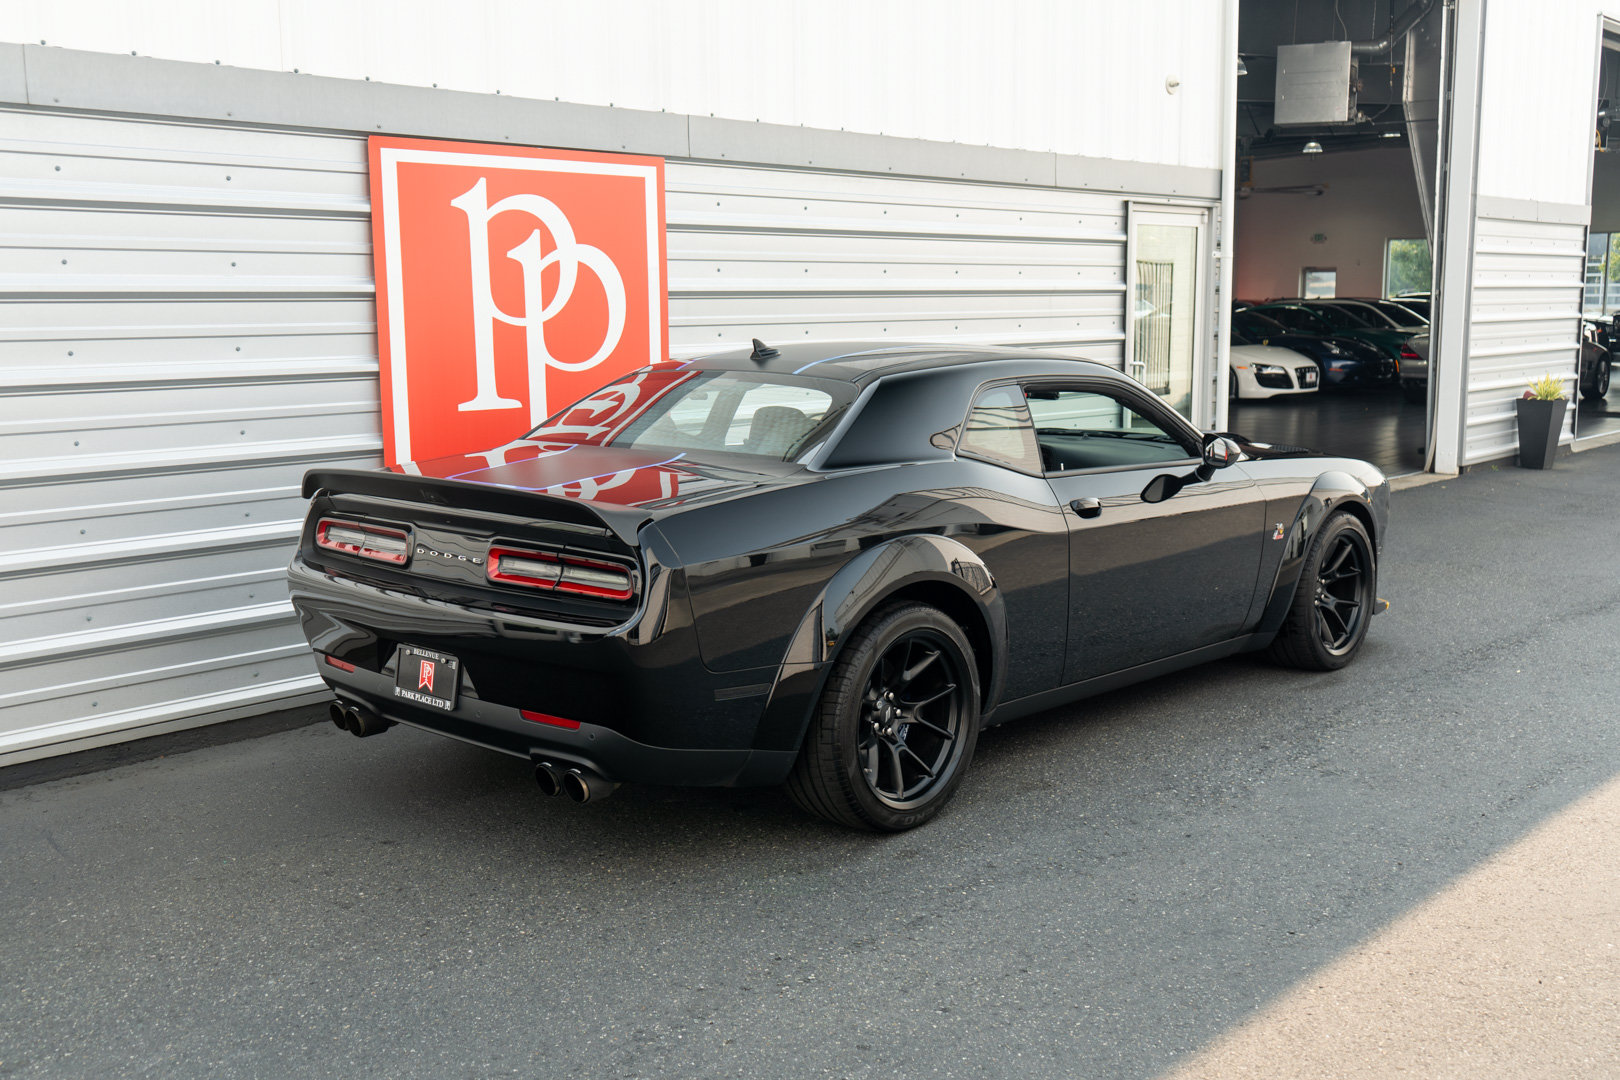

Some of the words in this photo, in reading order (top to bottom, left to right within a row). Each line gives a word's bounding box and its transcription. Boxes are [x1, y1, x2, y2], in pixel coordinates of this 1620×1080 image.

[417, 548, 482, 564] DODGE
[413, 648, 439, 660] BELLEVUE
[401, 690, 415, 700] PARK
[415, 694, 432, 704] PLACE
[432, 699, 444, 708] LTD
